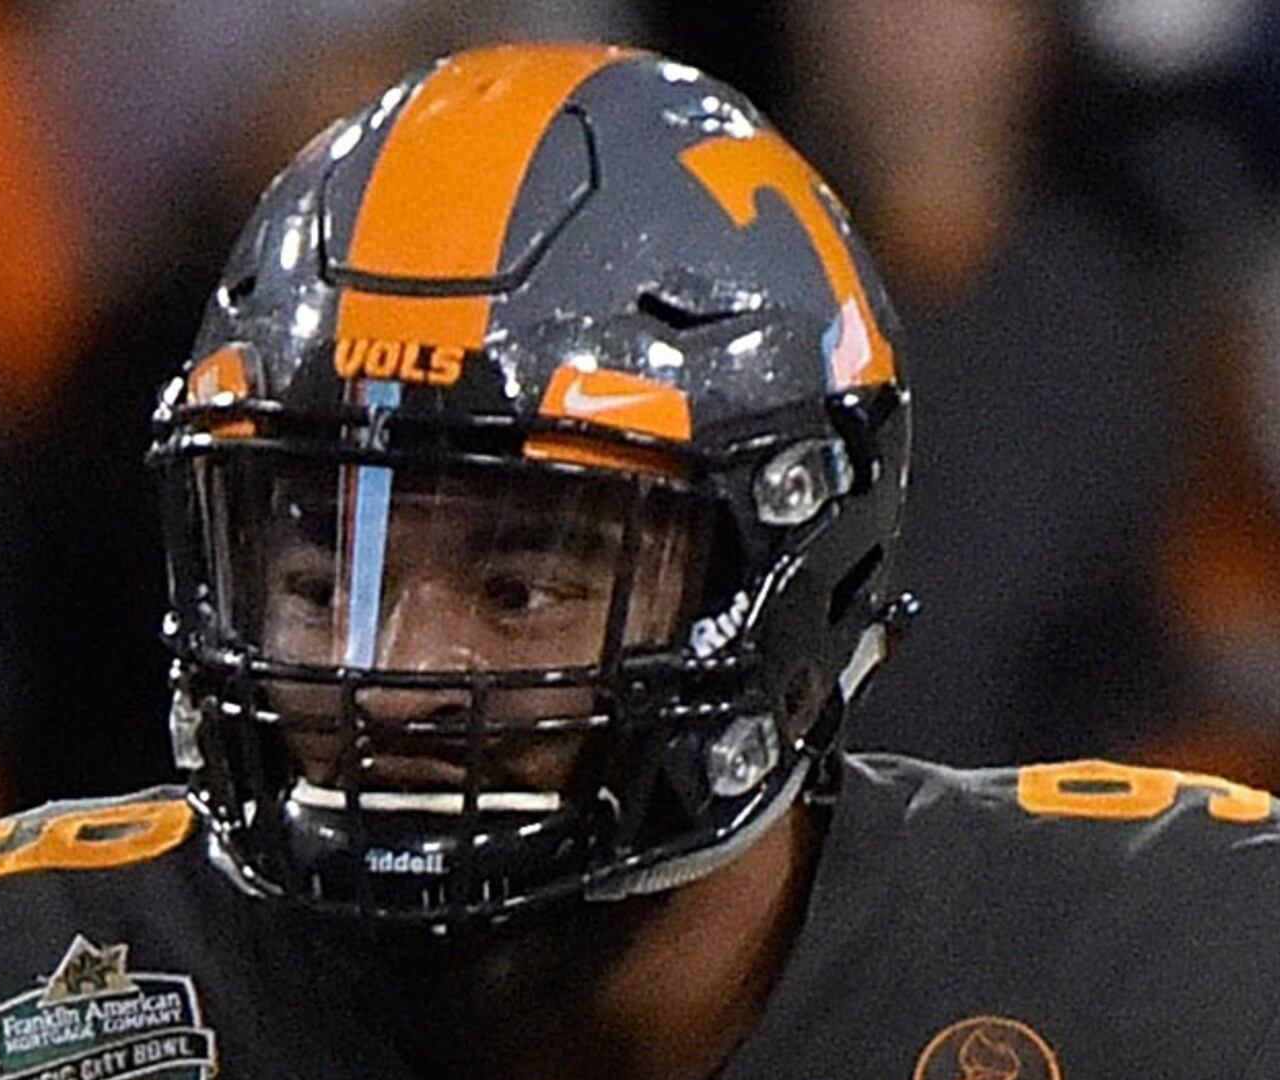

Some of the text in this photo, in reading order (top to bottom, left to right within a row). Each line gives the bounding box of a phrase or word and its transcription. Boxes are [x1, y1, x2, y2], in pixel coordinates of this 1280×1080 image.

[333, 338, 466, 385] VOLS
[1017, 759, 1272, 824] 9
[2, 990, 182, 1038] Franklin American
[103, 1008, 183, 1033] COMPANY
[132, 1036, 195, 1065] BOWL
